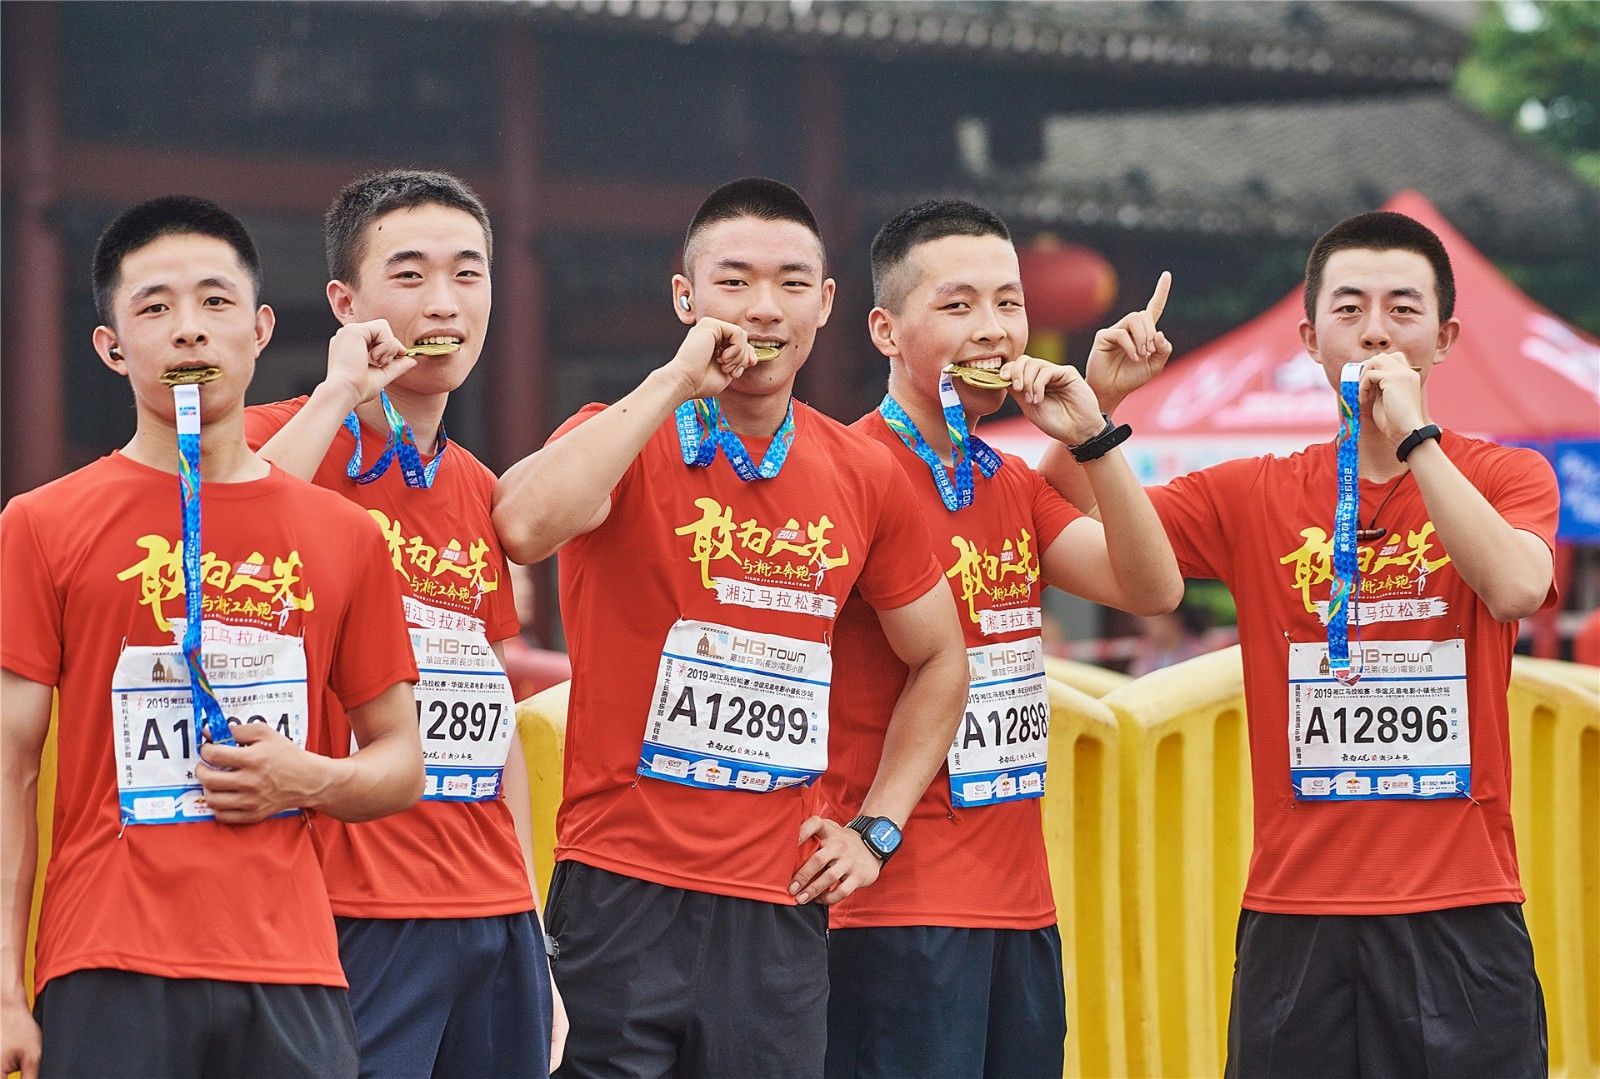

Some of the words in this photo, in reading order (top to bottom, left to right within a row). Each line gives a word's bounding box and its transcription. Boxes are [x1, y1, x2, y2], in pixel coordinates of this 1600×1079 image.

[777, 529, 798, 540] 2019
[741, 557, 812, 582] 与湘江奔跑
[724, 584, 824, 613] 湘江马拉松赛
[1347, 601, 1432, 622] 江马拉松赛
[415, 700, 502, 742] 12897
[667, 685, 809, 745] A12899
[963, 702, 1048, 750] A12898
[1304, 705, 1449, 744] A12896
[138, 713, 294, 760] A14
